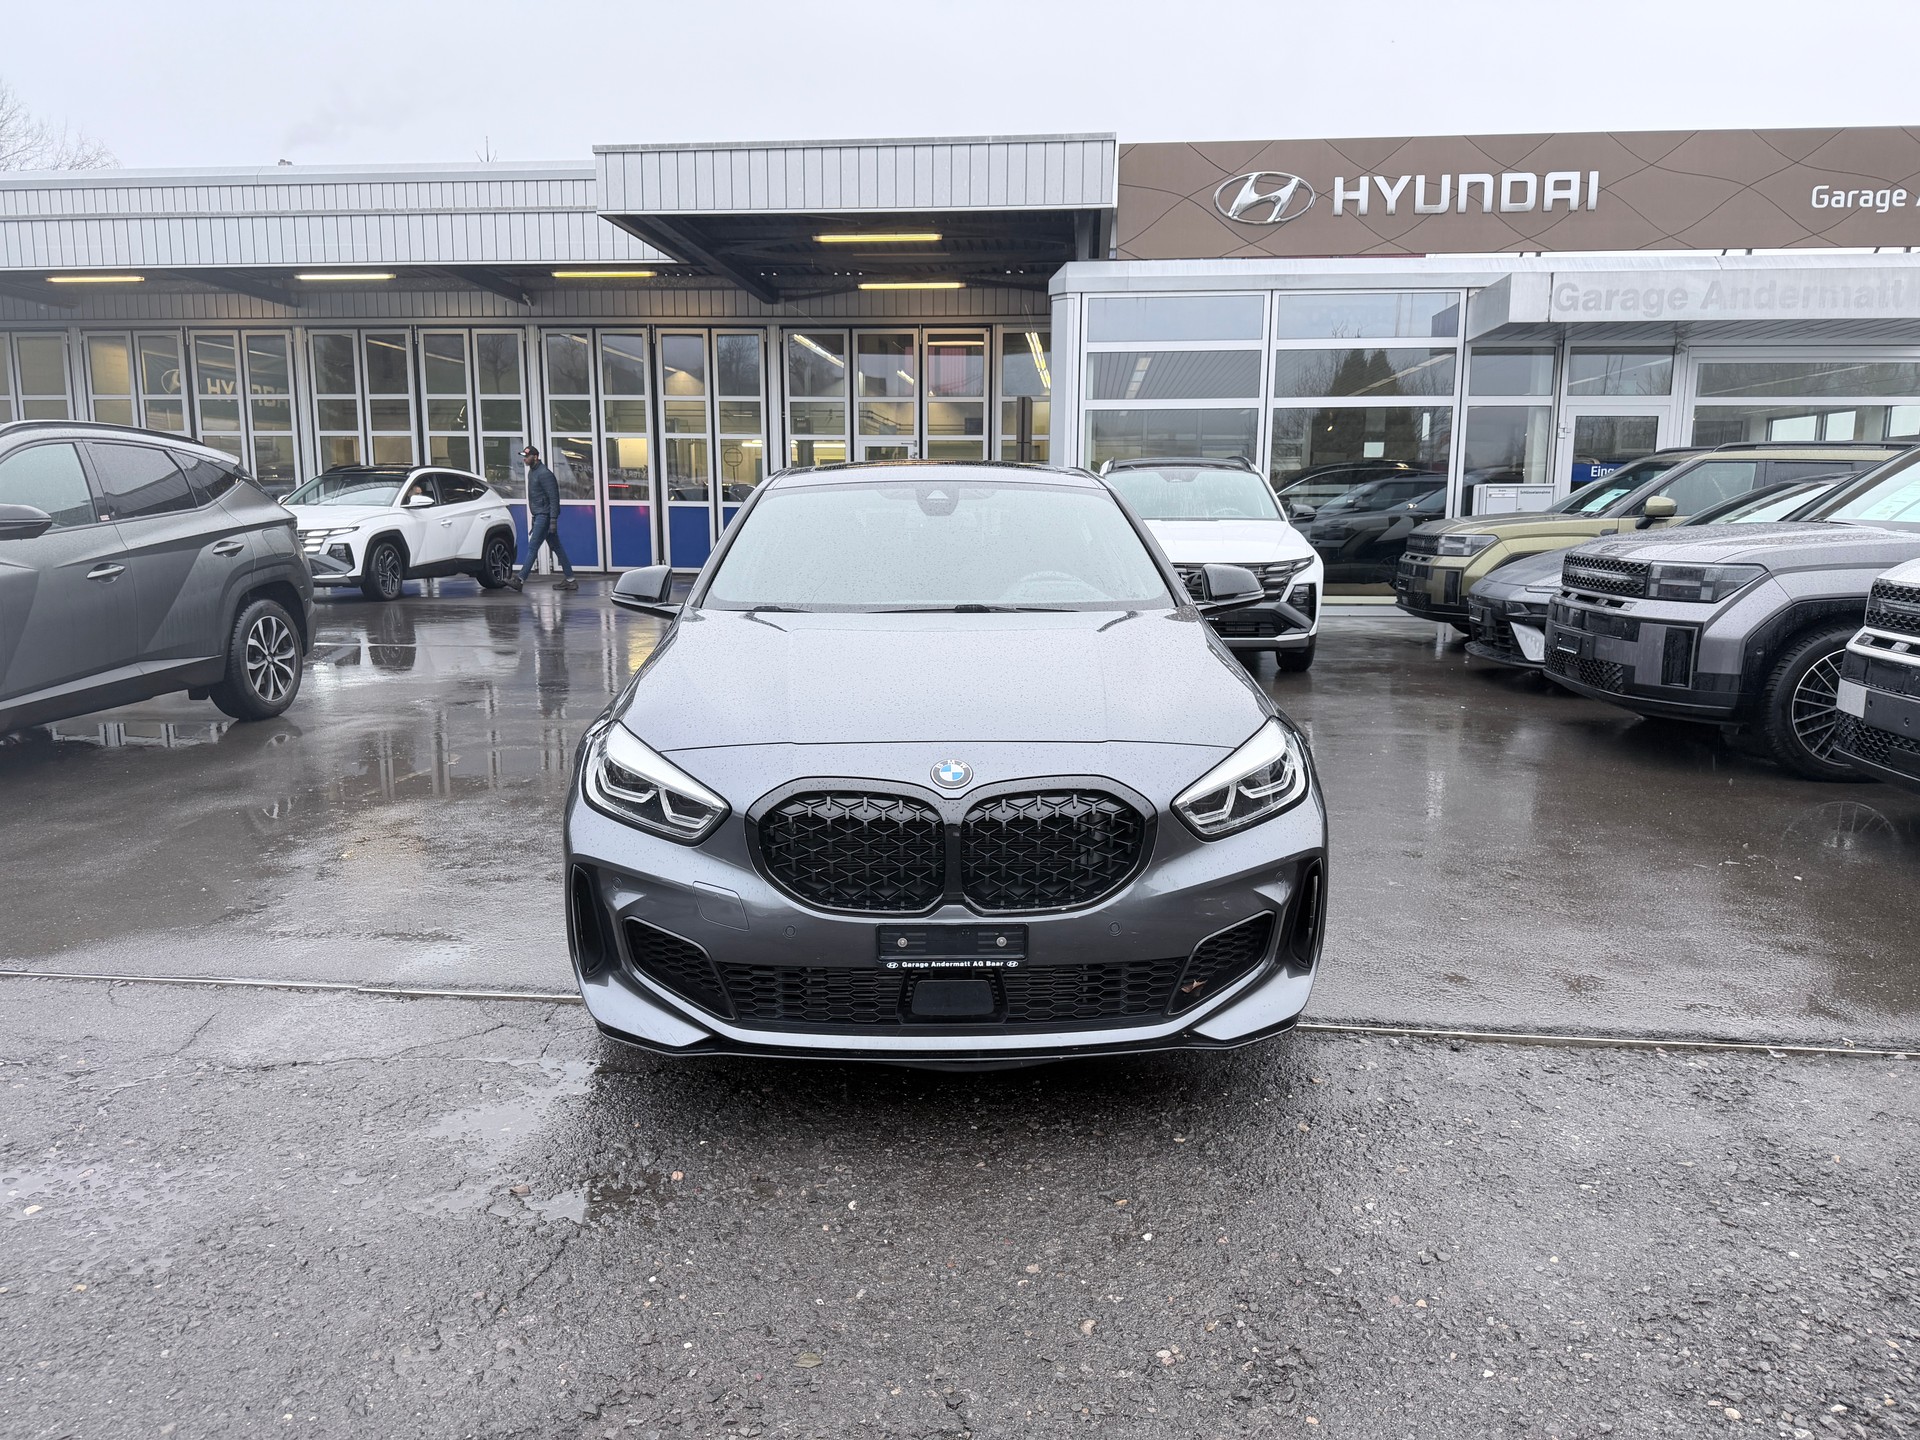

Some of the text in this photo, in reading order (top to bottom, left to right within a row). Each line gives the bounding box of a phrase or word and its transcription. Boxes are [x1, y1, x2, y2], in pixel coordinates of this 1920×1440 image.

[1332, 171, 1599, 216] HYUNDAI
[1811, 185, 1908, 213] Garage
[1553, 279, 1904, 318] Garage Andermatt
